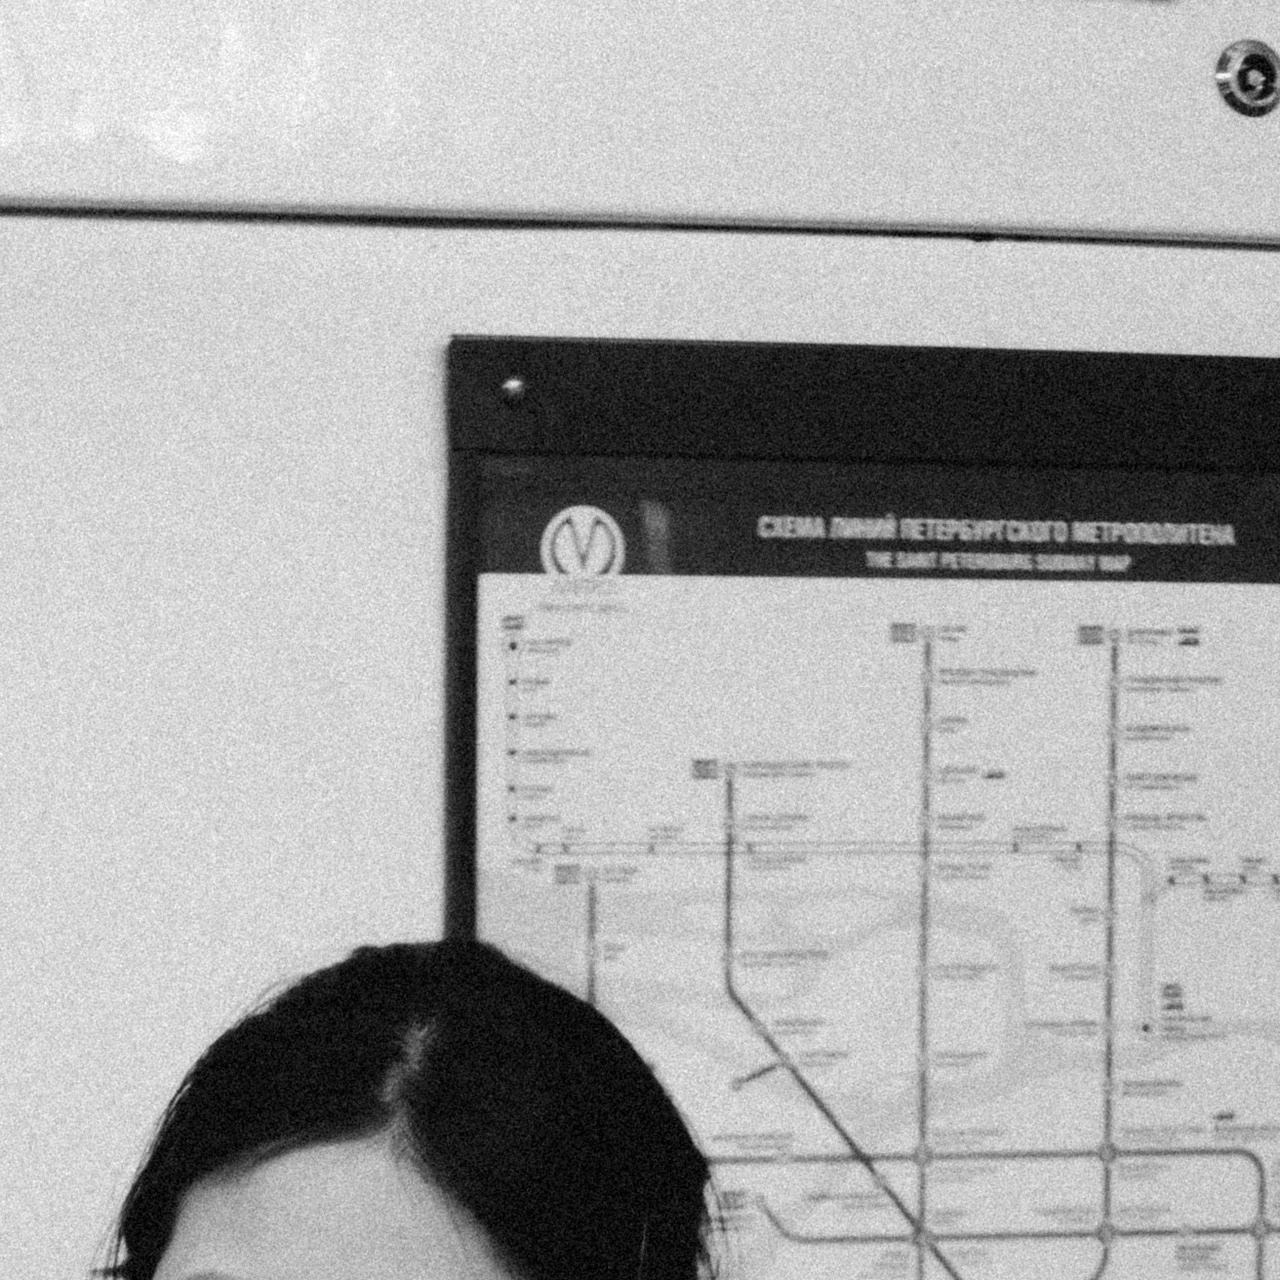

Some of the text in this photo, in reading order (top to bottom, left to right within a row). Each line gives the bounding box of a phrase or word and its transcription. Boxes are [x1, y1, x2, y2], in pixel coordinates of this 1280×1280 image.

[757, 512, 1237, 546] СХЕМА ЛИНИЙ ПЕТЕРБУРГСКОГО МЕТРОПОЛИТЕНА
